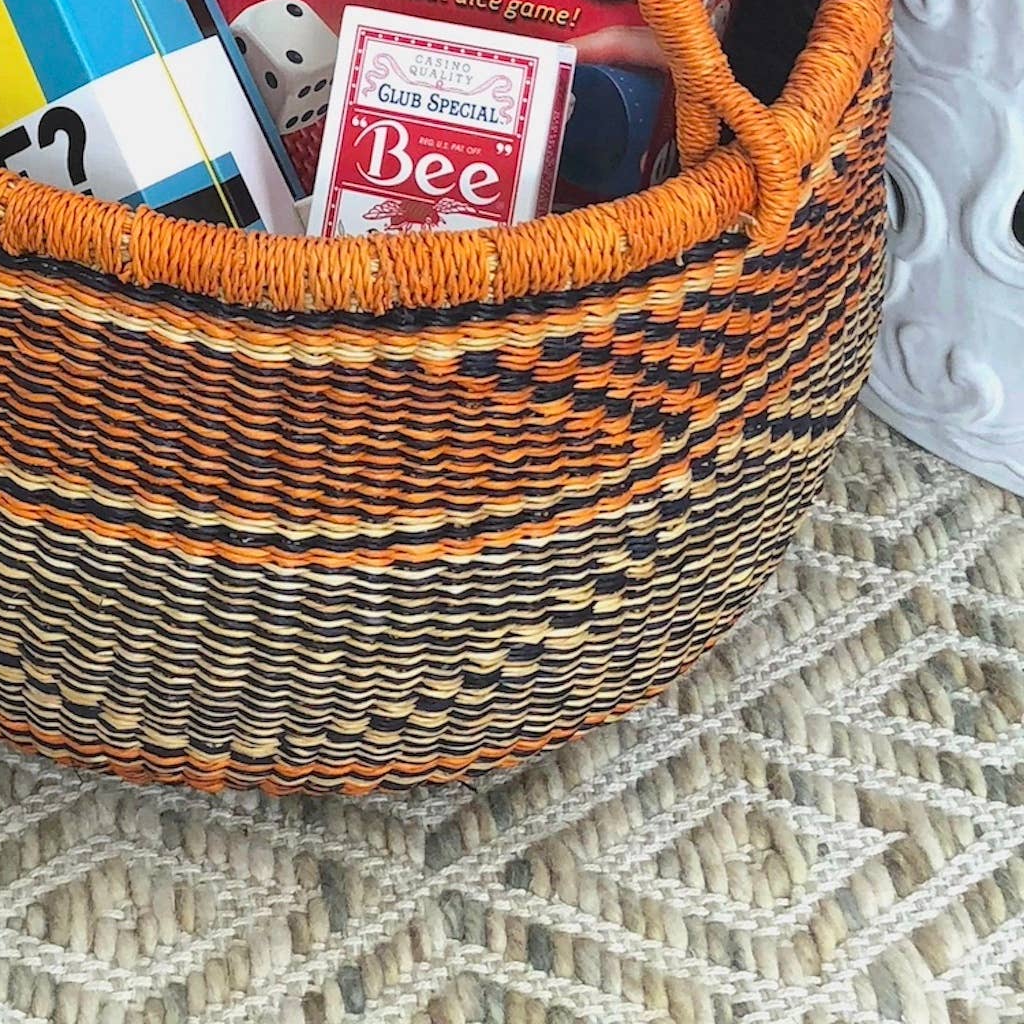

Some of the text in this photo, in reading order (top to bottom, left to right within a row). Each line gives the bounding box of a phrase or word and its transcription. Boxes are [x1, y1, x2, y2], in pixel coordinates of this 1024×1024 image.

[415, 54, 472, 73] CASINO
[409, 64, 474, 85] QUALITY
[378, 83, 422, 108] CLUB
